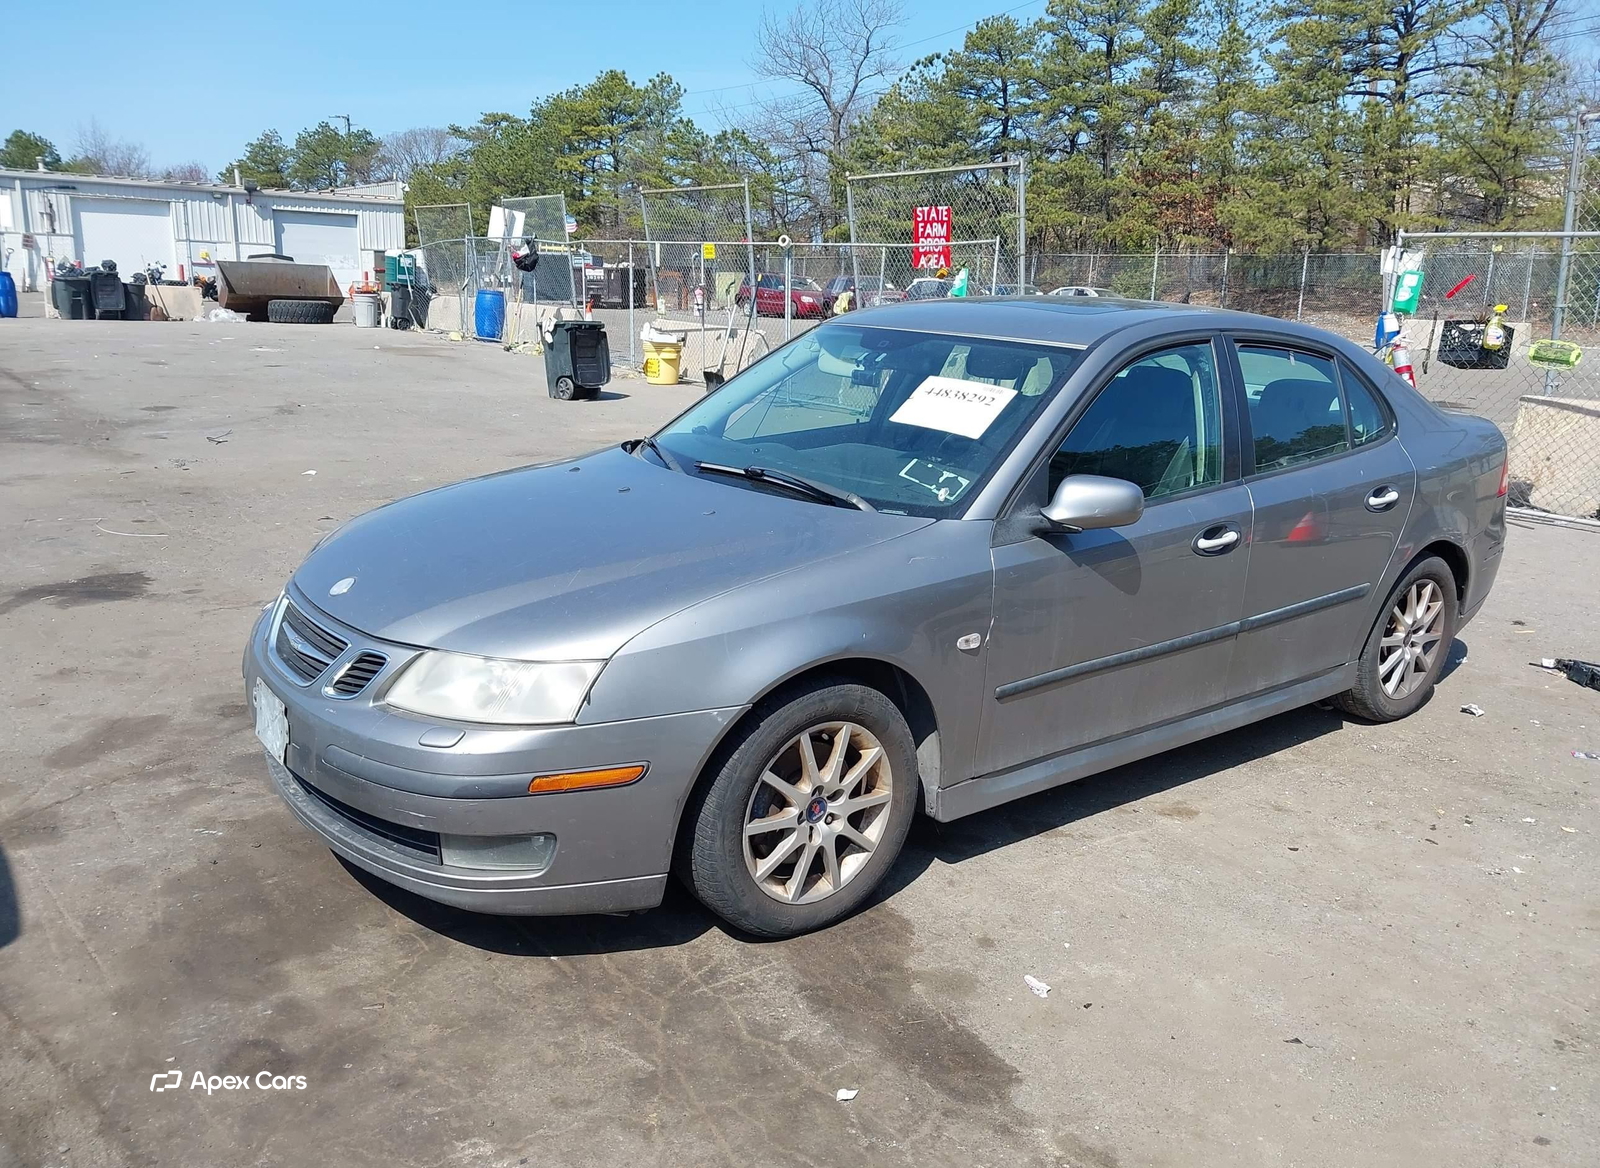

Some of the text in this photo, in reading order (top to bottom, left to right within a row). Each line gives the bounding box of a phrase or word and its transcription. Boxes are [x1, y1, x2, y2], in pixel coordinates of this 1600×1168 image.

[916, 206, 948, 221] STATE
[919, 223, 947, 238] FARM
[919, 238, 947, 252] DROP
[925, 387, 996, 406] 44838292
